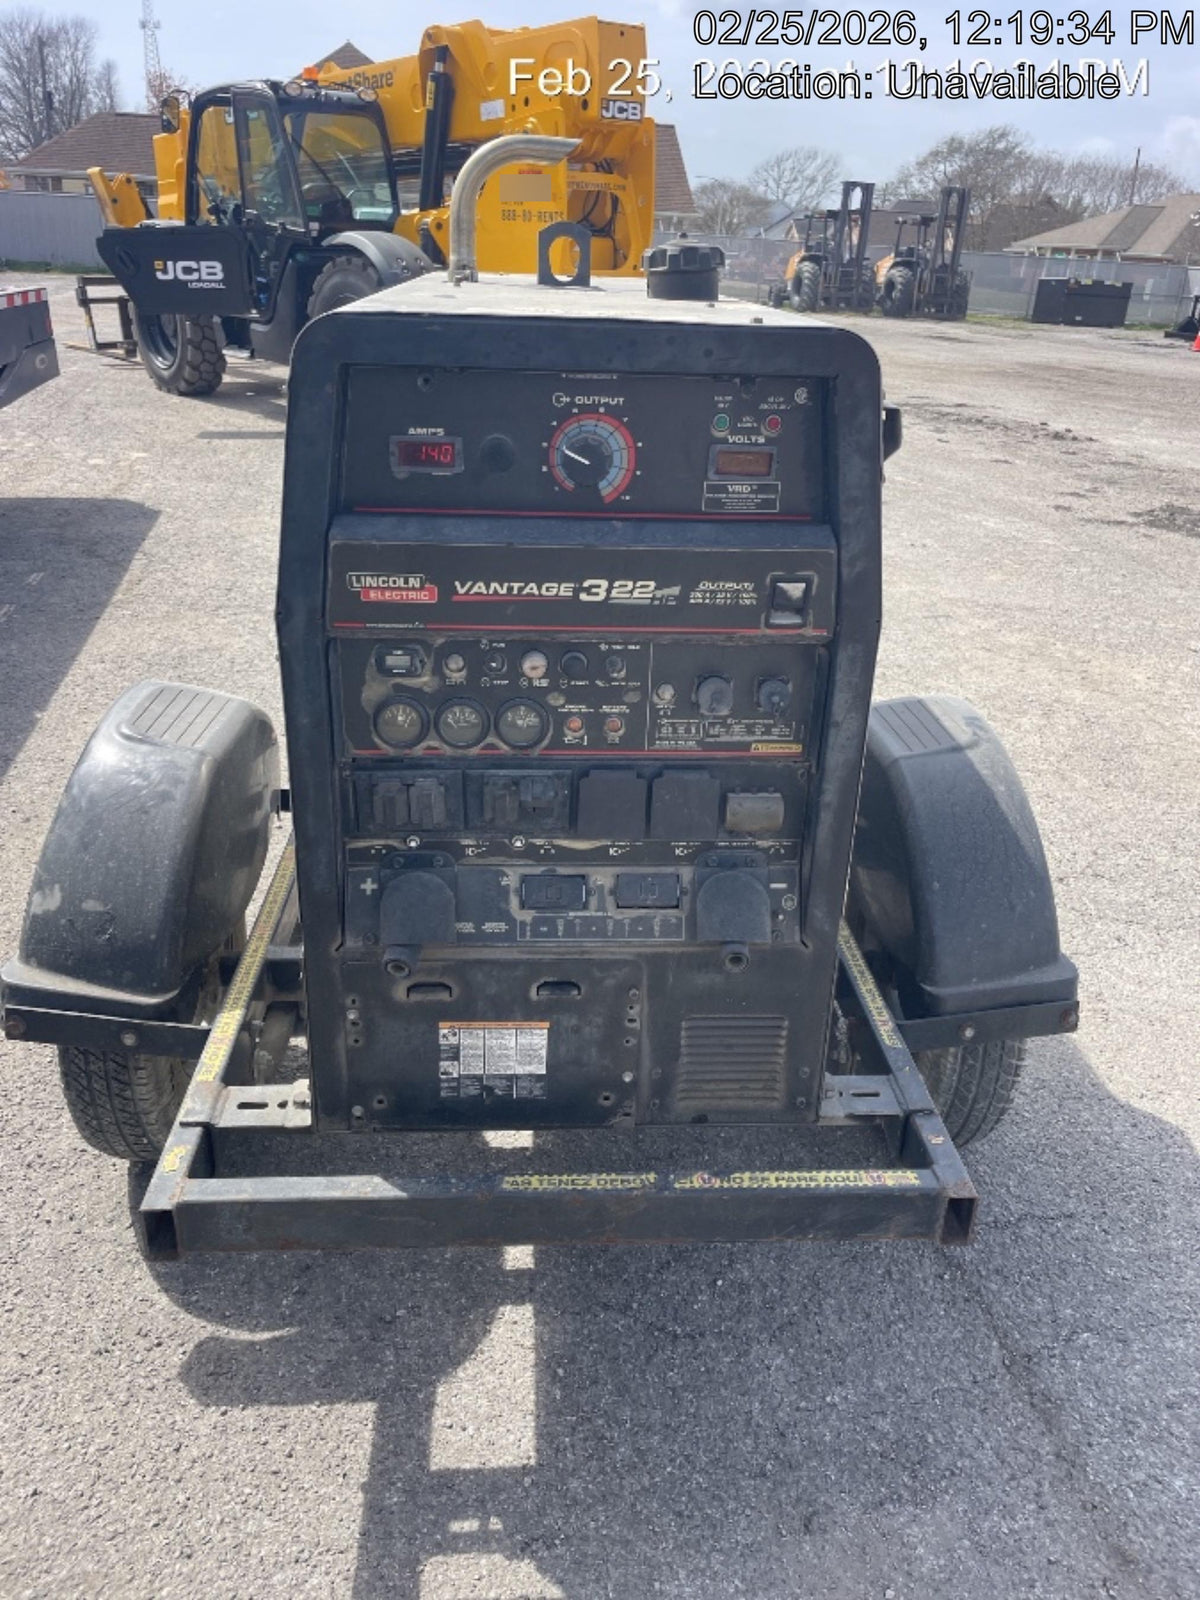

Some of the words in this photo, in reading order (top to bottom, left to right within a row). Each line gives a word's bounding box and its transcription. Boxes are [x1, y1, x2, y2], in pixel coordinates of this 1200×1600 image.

[601, 99, 642, 120] JCB
[154, 260, 225, 281] JCB
[574, 395, 625, 406] OUTPUT
[407, 427, 445, 436] AMPS
[727, 434, 765, 444] VOLTS
[420, 444, 453, 464] 140
[351, 575, 422, 588] LINCOLN
[369, 591, 430, 601] ELECTRIC
[453, 580, 575, 597] VANTAGE
[578, 578, 656, 602] 322
[537, 1177, 594, 1189] TENEZ
[774, 1173, 819, 1185] PARE
